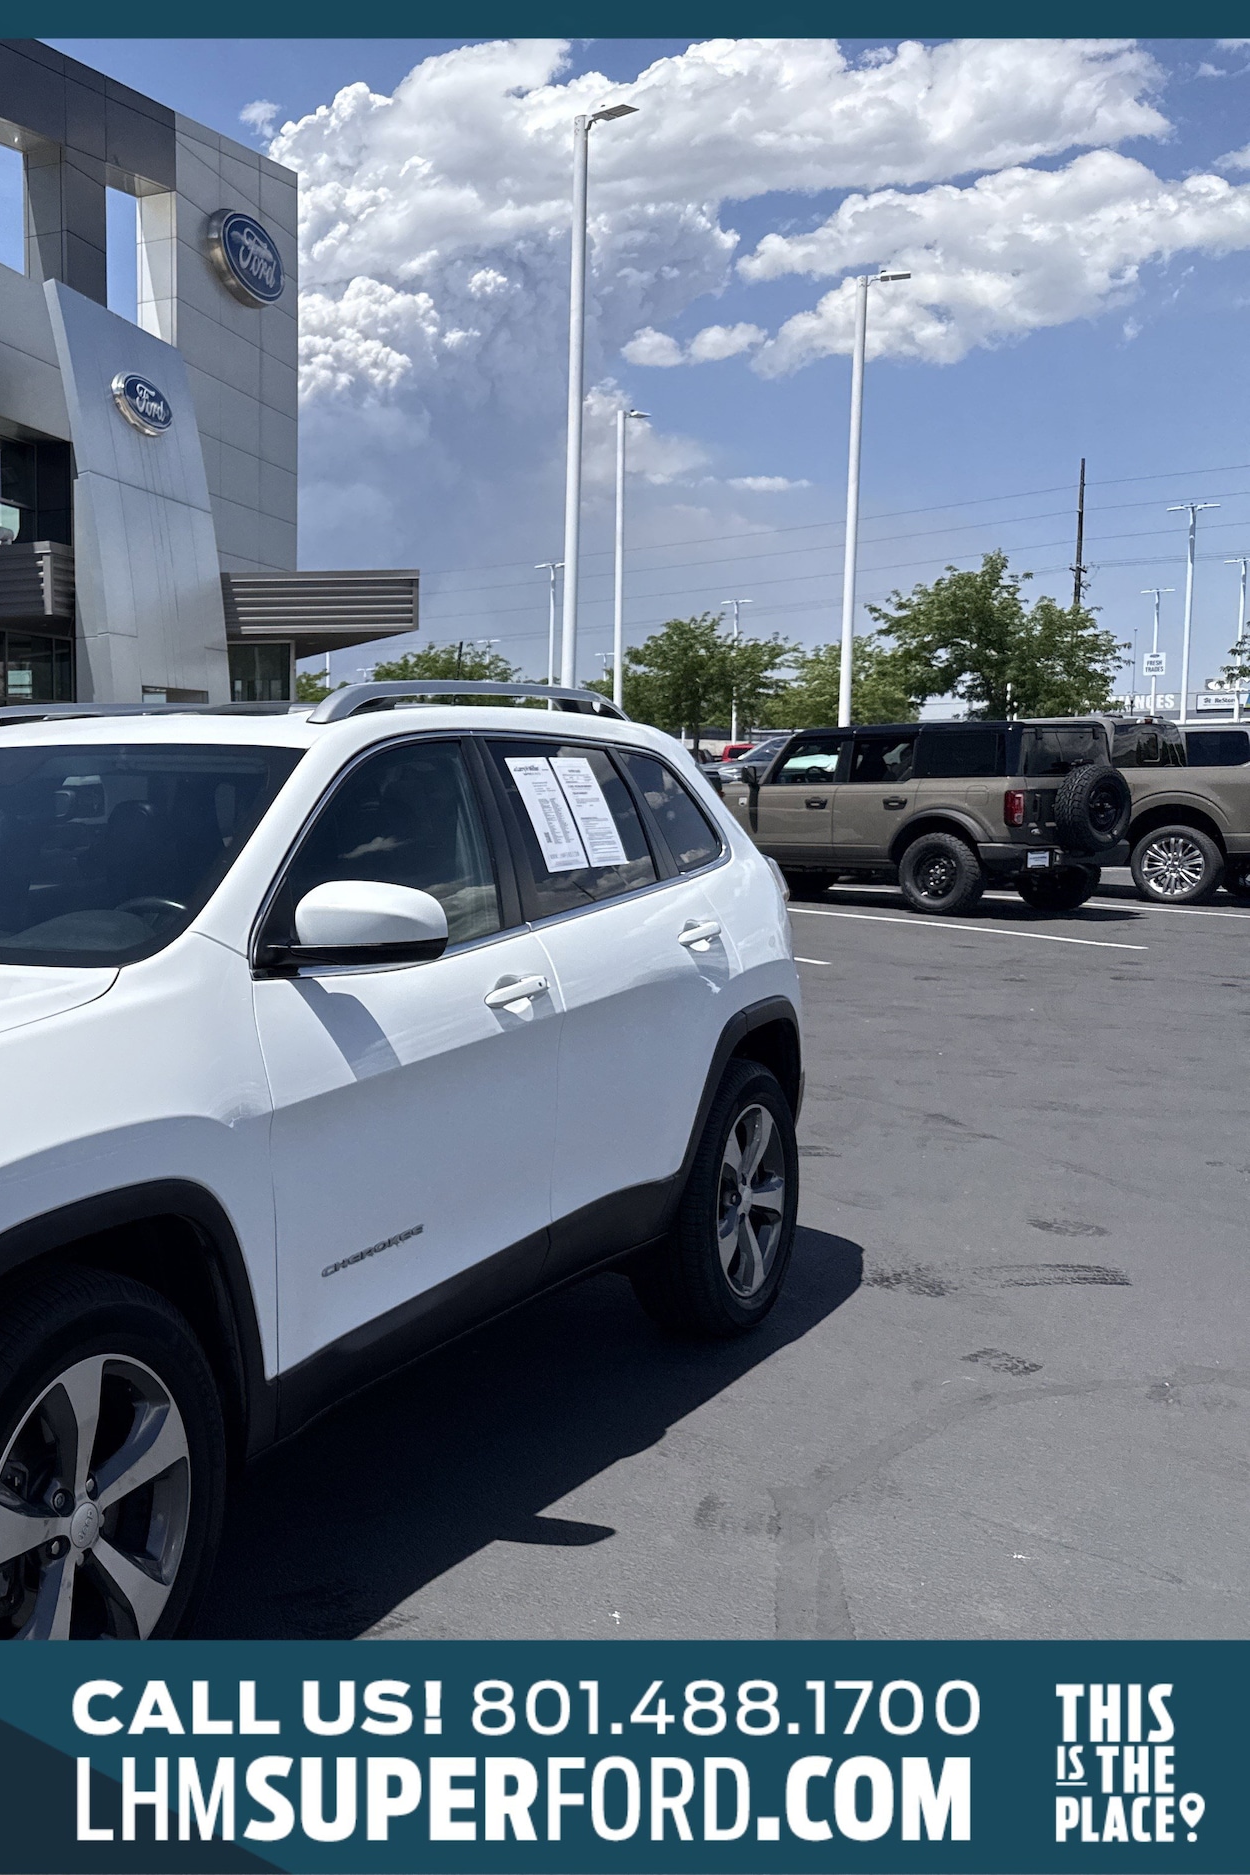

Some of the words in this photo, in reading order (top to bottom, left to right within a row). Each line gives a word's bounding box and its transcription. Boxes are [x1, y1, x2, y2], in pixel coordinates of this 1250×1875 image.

[231, 227, 276, 288] Ford
[135, 382, 167, 422] Ford
[321, 1223, 424, 1278] CHEROKEE
